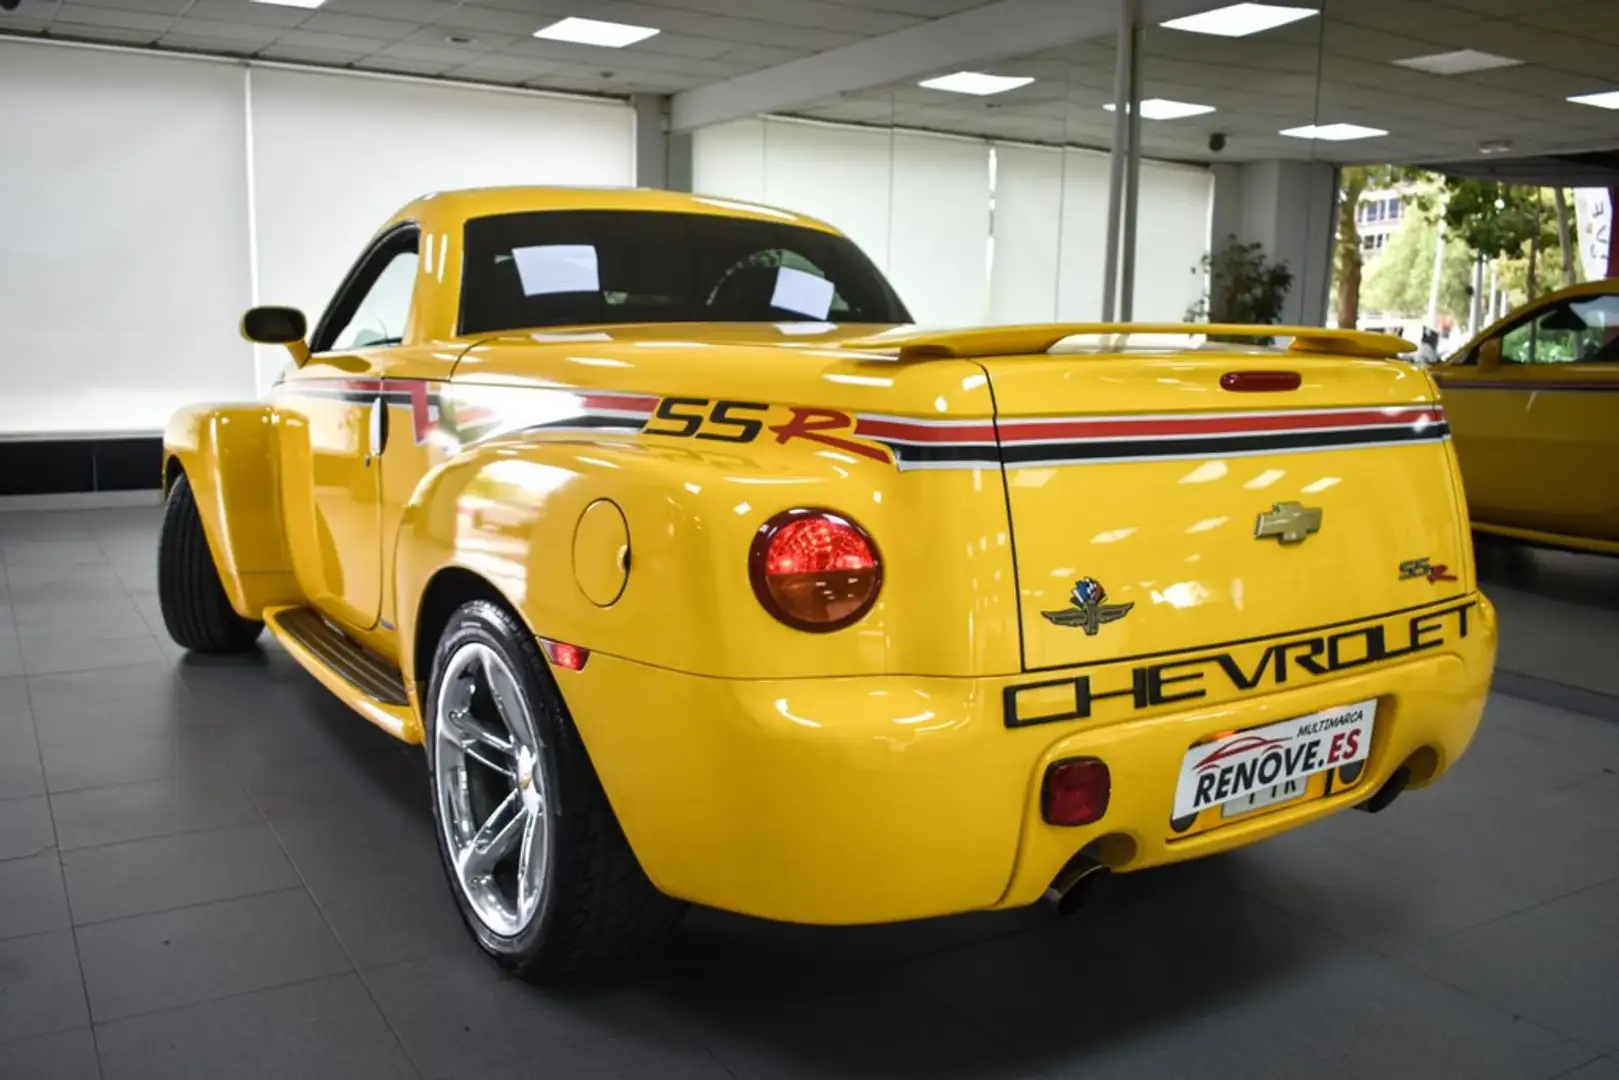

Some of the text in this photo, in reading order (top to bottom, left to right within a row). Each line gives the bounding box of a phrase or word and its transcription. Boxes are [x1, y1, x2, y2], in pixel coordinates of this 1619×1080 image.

[643, 397, 892, 464] SSR
[1398, 556, 1458, 585] SSR
[1003, 601, 1477, 729] CHEVROLET
[1296, 709, 1364, 737] MULTIMARCA
[1193, 728, 1362, 807] RENOVE.ES
